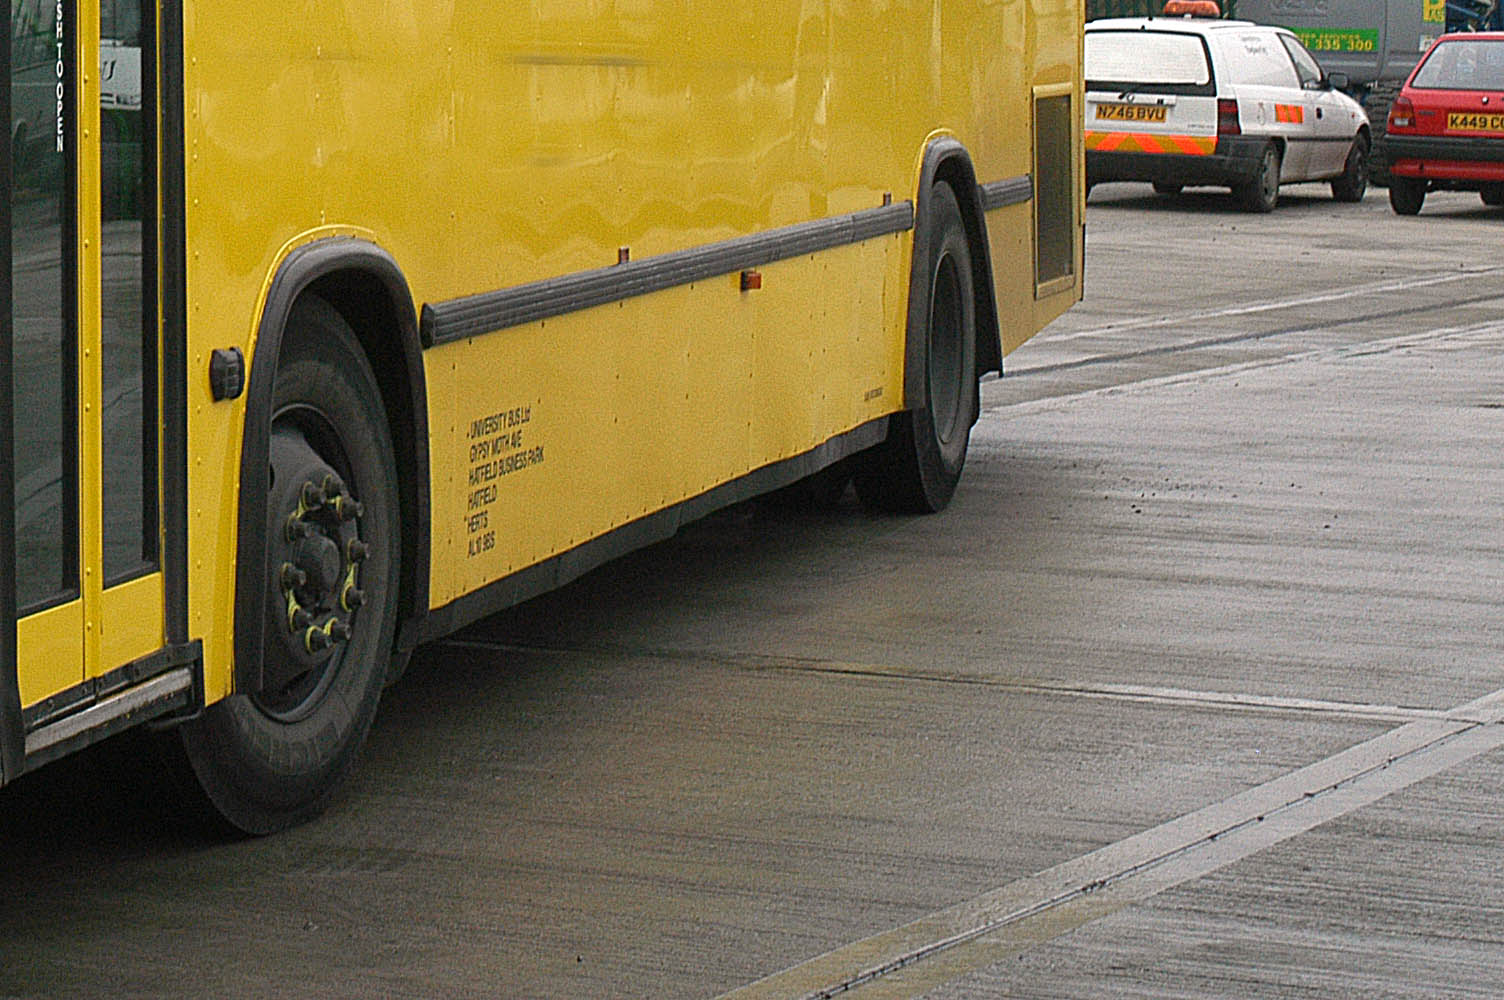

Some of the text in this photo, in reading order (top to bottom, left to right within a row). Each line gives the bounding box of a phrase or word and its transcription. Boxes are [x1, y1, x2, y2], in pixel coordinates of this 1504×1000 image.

[55, 42, 65, 79] TO
[56, 81, 65, 153] OPEN
[1098, 104, 1134, 120] N746
[1449, 115, 1489, 129] K449
